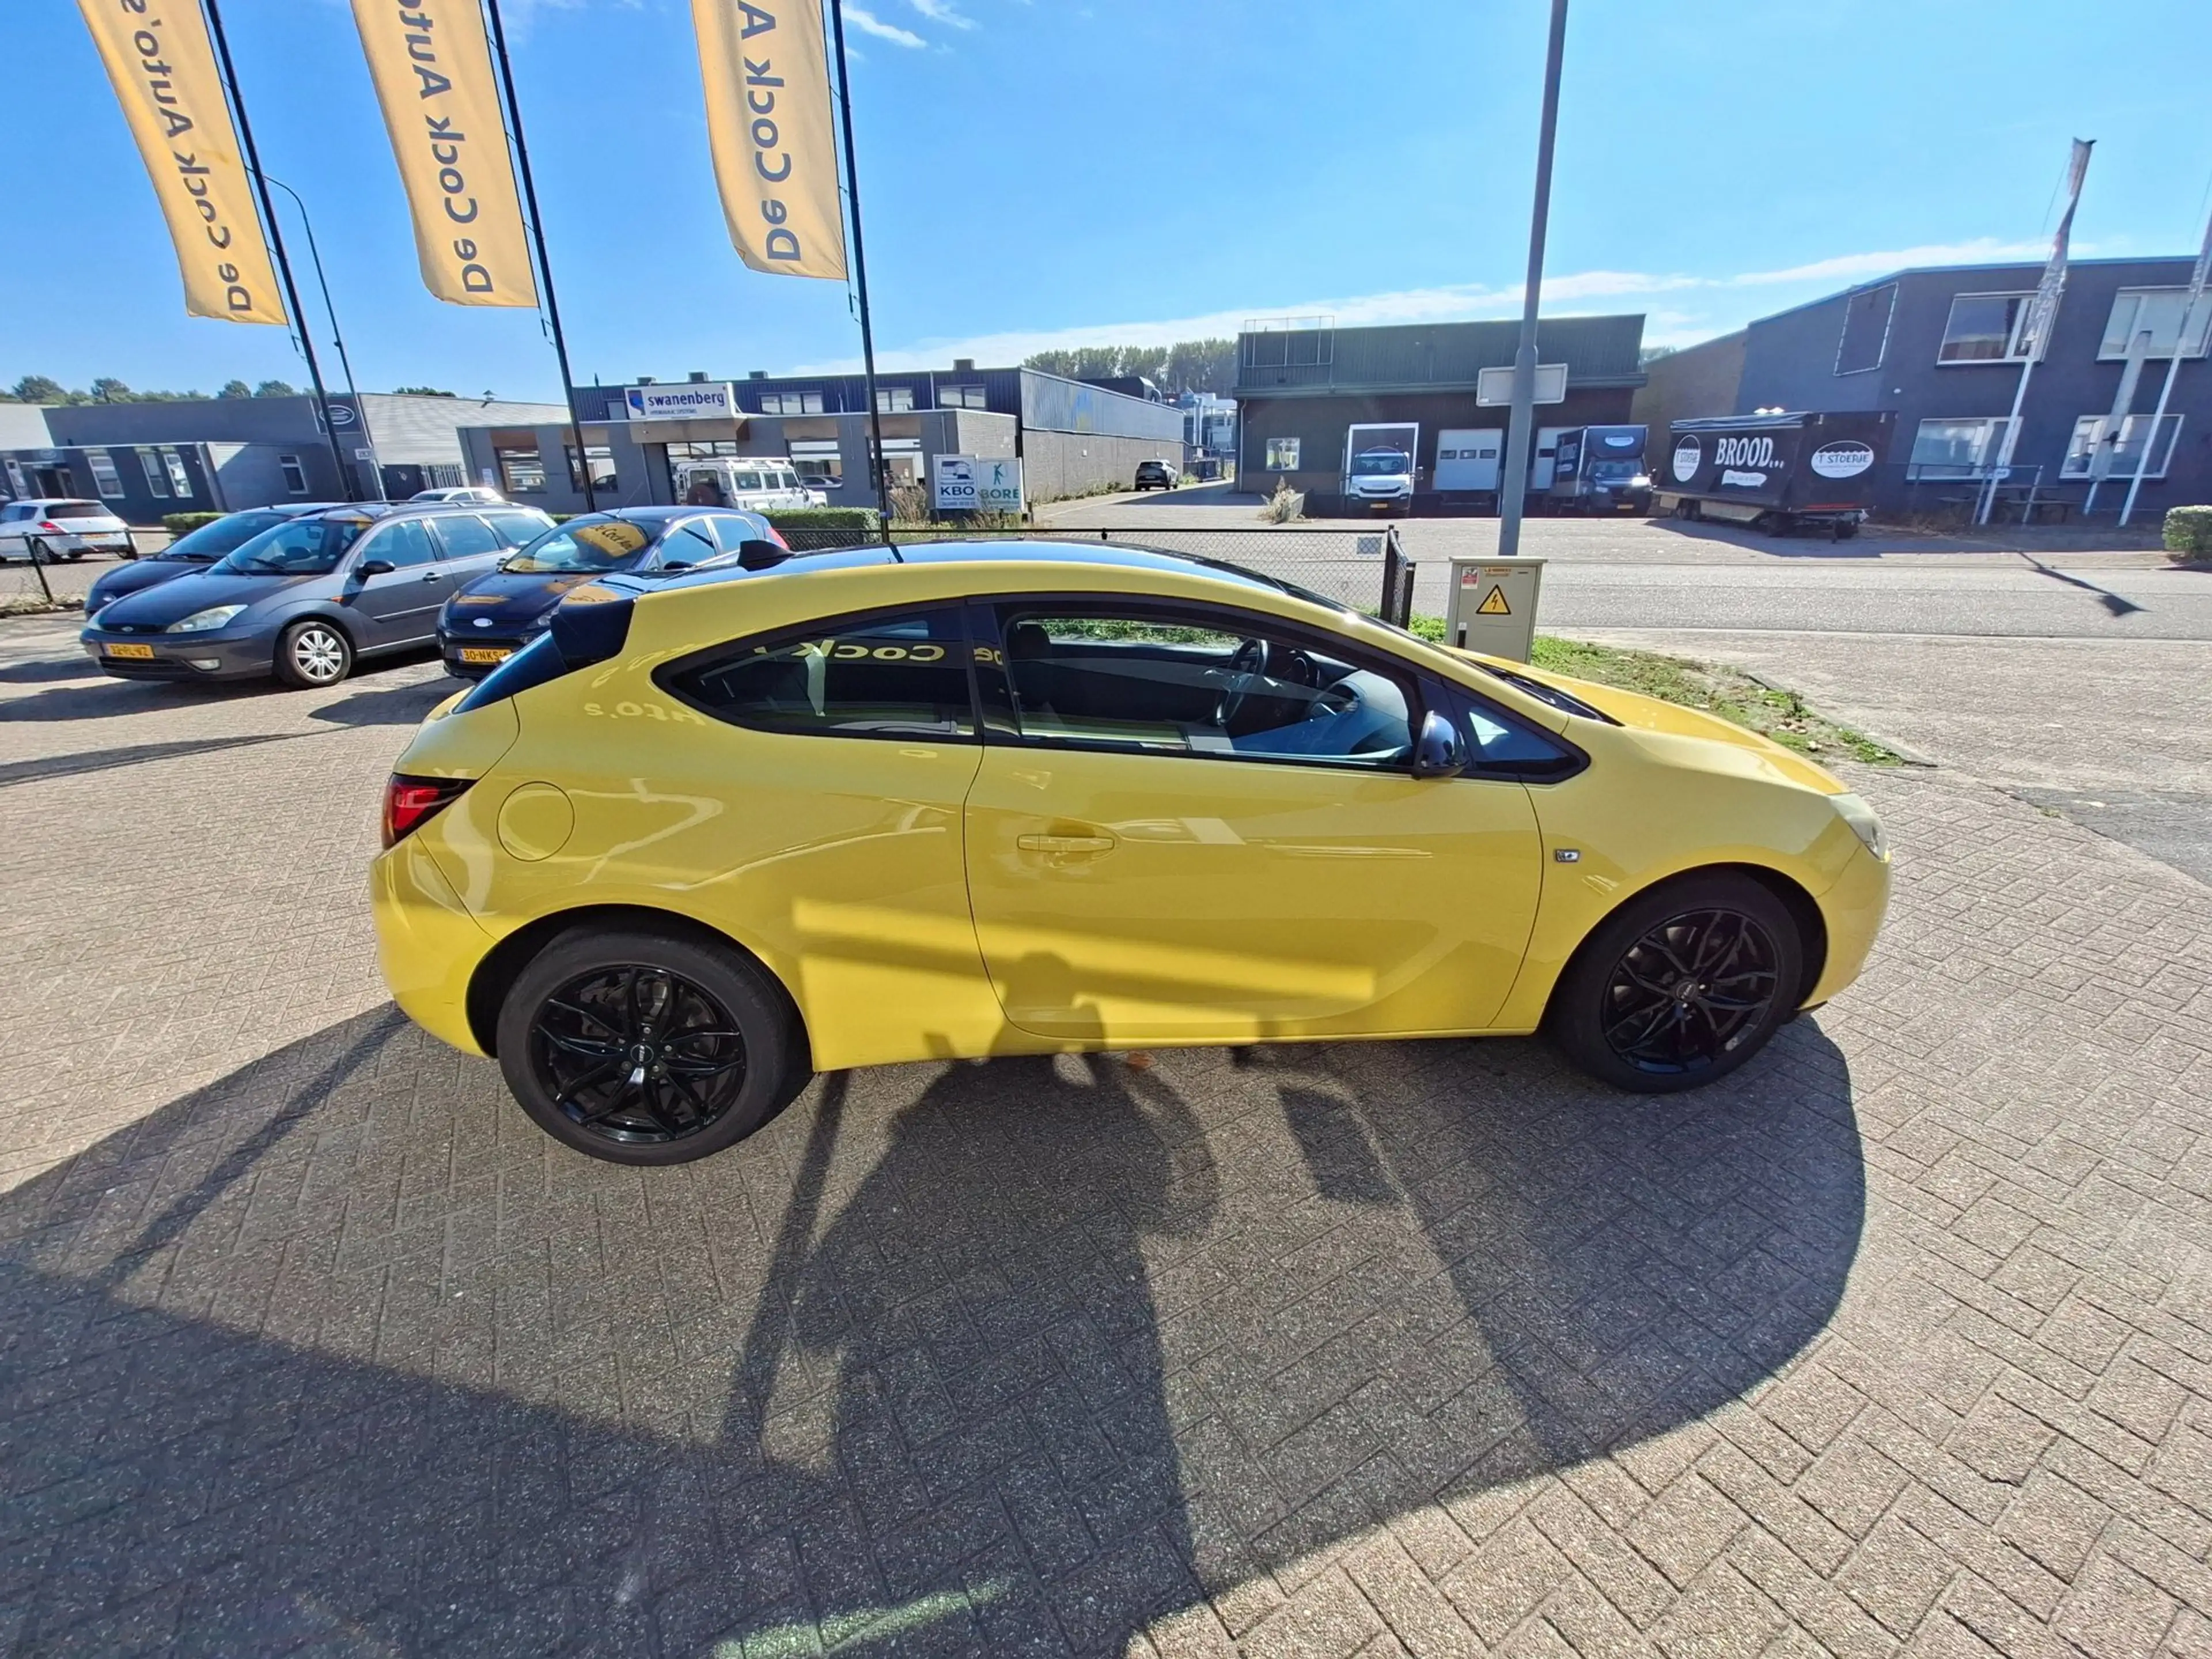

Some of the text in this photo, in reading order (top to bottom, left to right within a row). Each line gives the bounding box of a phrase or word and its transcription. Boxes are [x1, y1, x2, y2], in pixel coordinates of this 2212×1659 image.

[647, 390, 725, 407] swanenberg
[941, 486, 975, 496] KBO
[980, 485, 1020, 499] BORÉ
